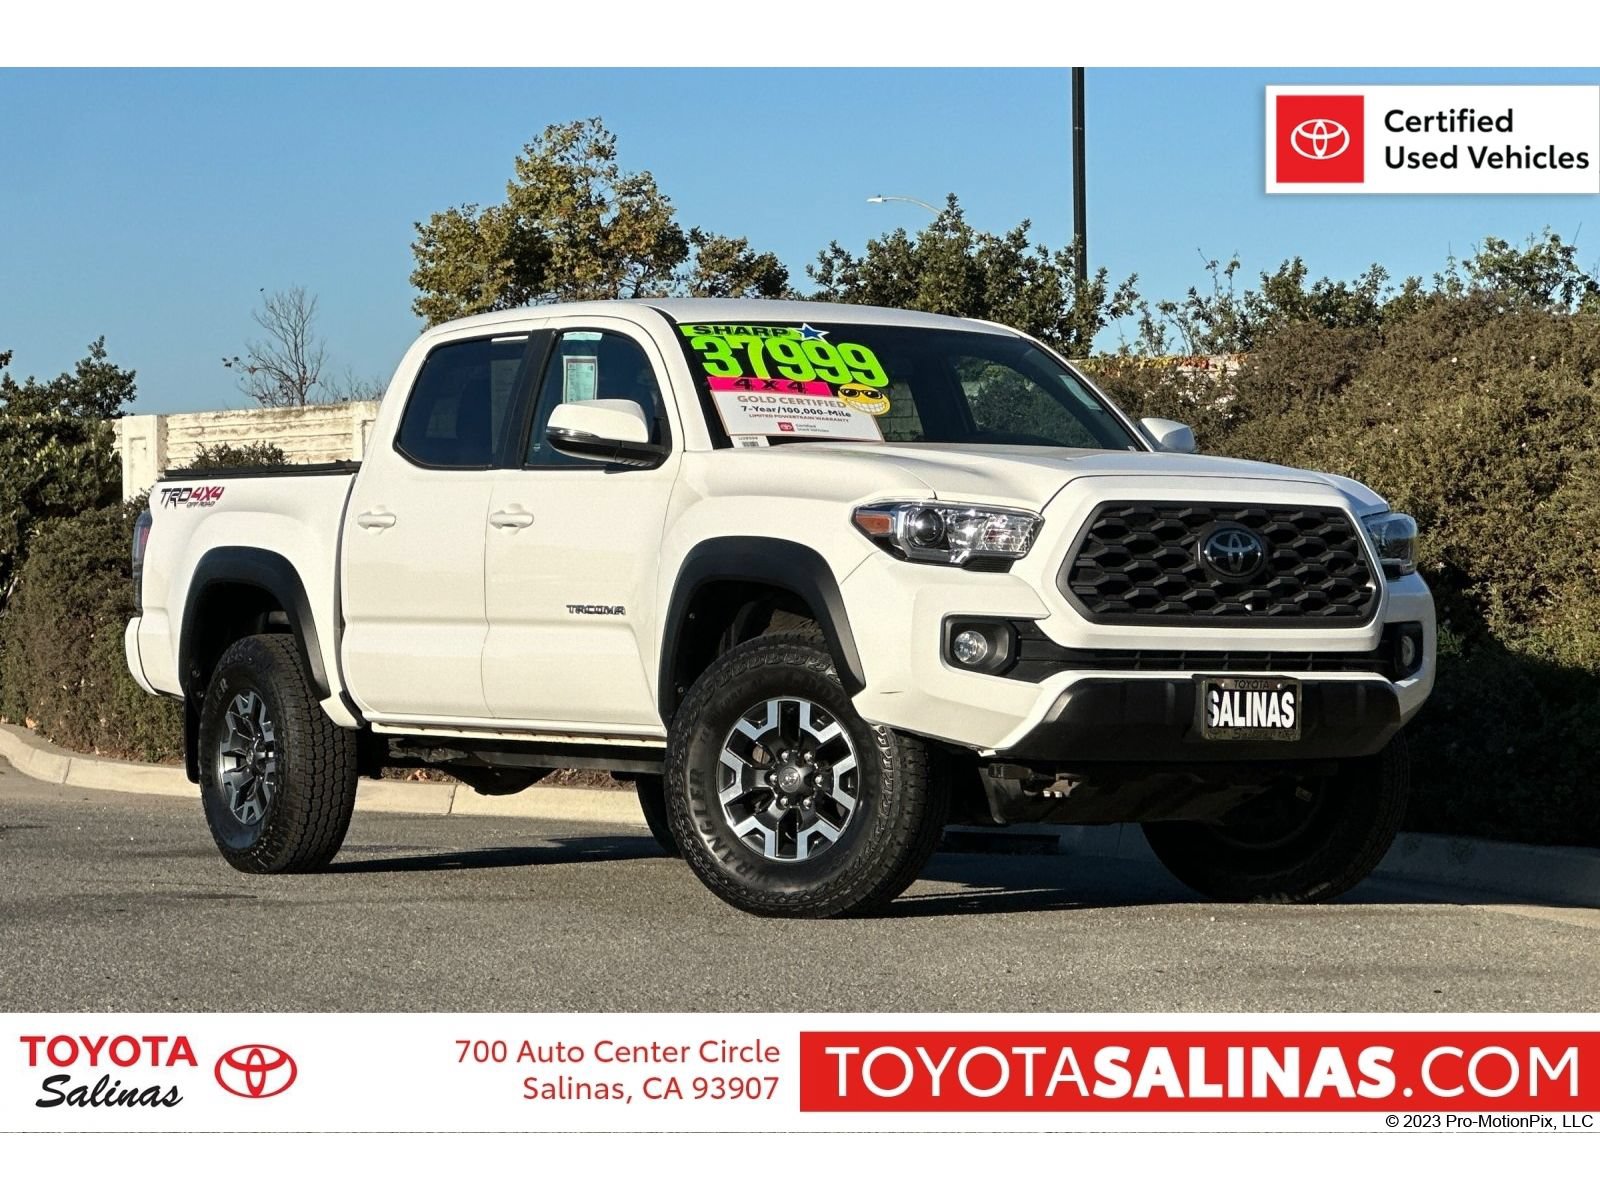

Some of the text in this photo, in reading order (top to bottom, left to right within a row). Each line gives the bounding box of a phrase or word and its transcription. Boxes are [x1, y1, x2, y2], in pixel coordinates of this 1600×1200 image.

[692, 325, 790, 338] SHARP
[691, 336, 889, 388] 37999
[737, 395, 847, 408] GOLD CERTIFIED
[741, 405, 852, 418] 7-Year/100,000-Mile
[160, 486, 225, 509] TRD 4X4
[566, 605, 626, 615] TACOMA
[1234, 680, 1270, 690] TOYOTA
[1207, 690, 1296, 729] SALINAS
